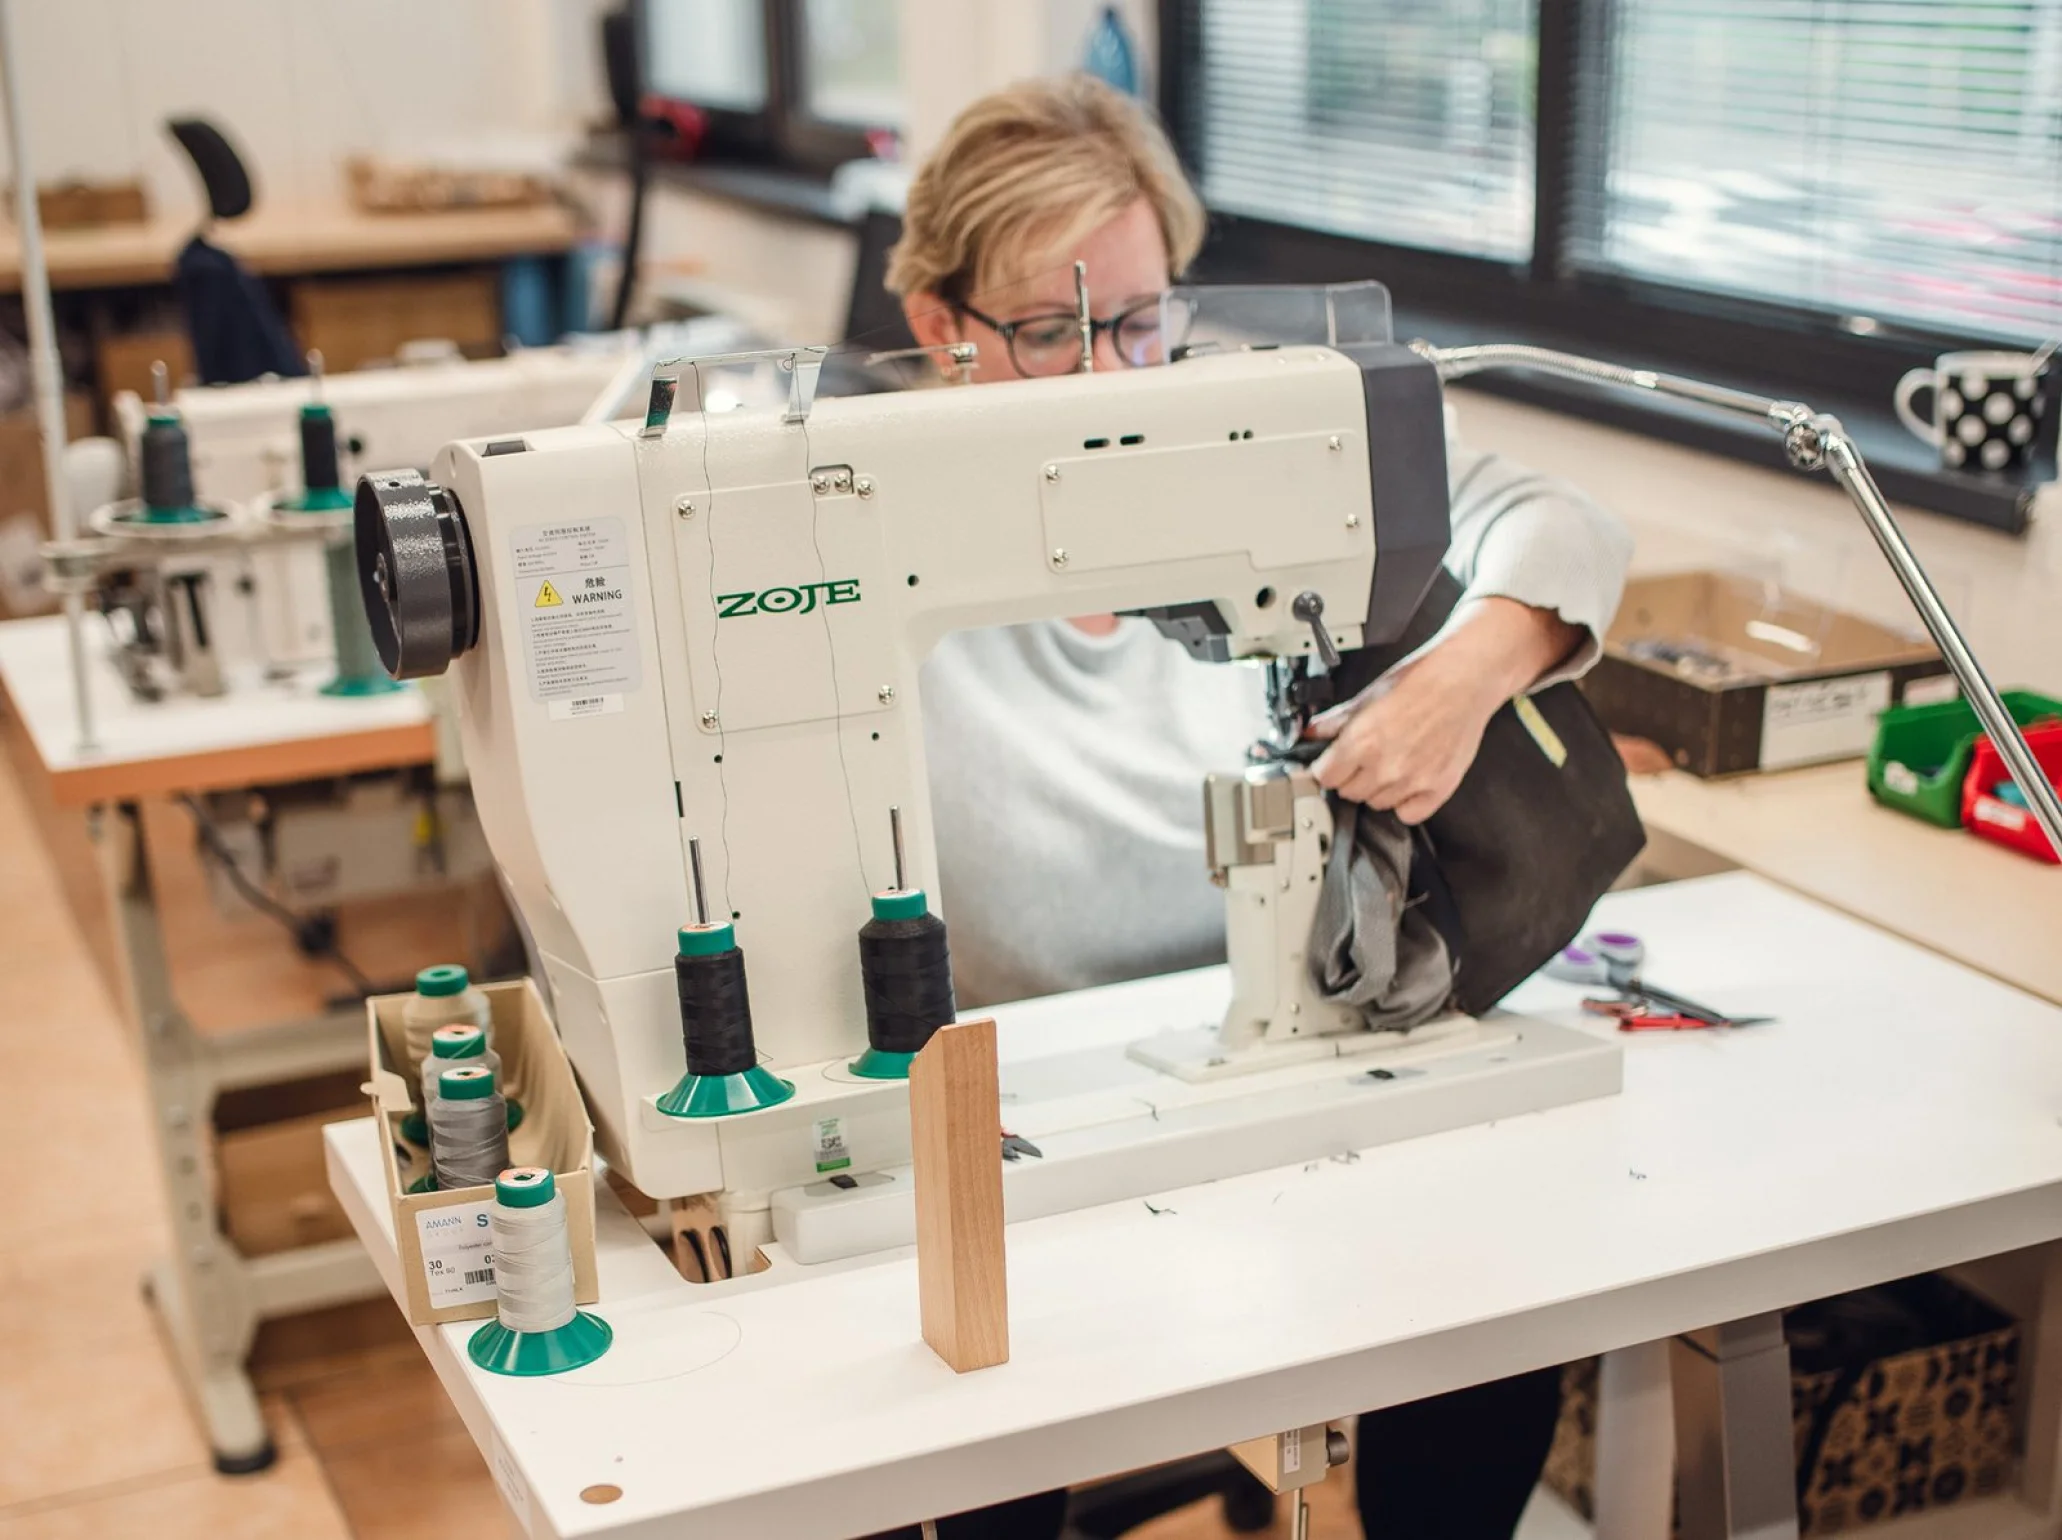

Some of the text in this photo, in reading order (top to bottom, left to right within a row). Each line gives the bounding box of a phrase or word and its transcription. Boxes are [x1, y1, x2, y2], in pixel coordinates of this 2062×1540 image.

[571, 589, 623, 605] WARNING
[717, 579, 861, 619] ZOJE
[426, 1216, 462, 1229] AMANN
[428, 1260, 443, 1270] 30
